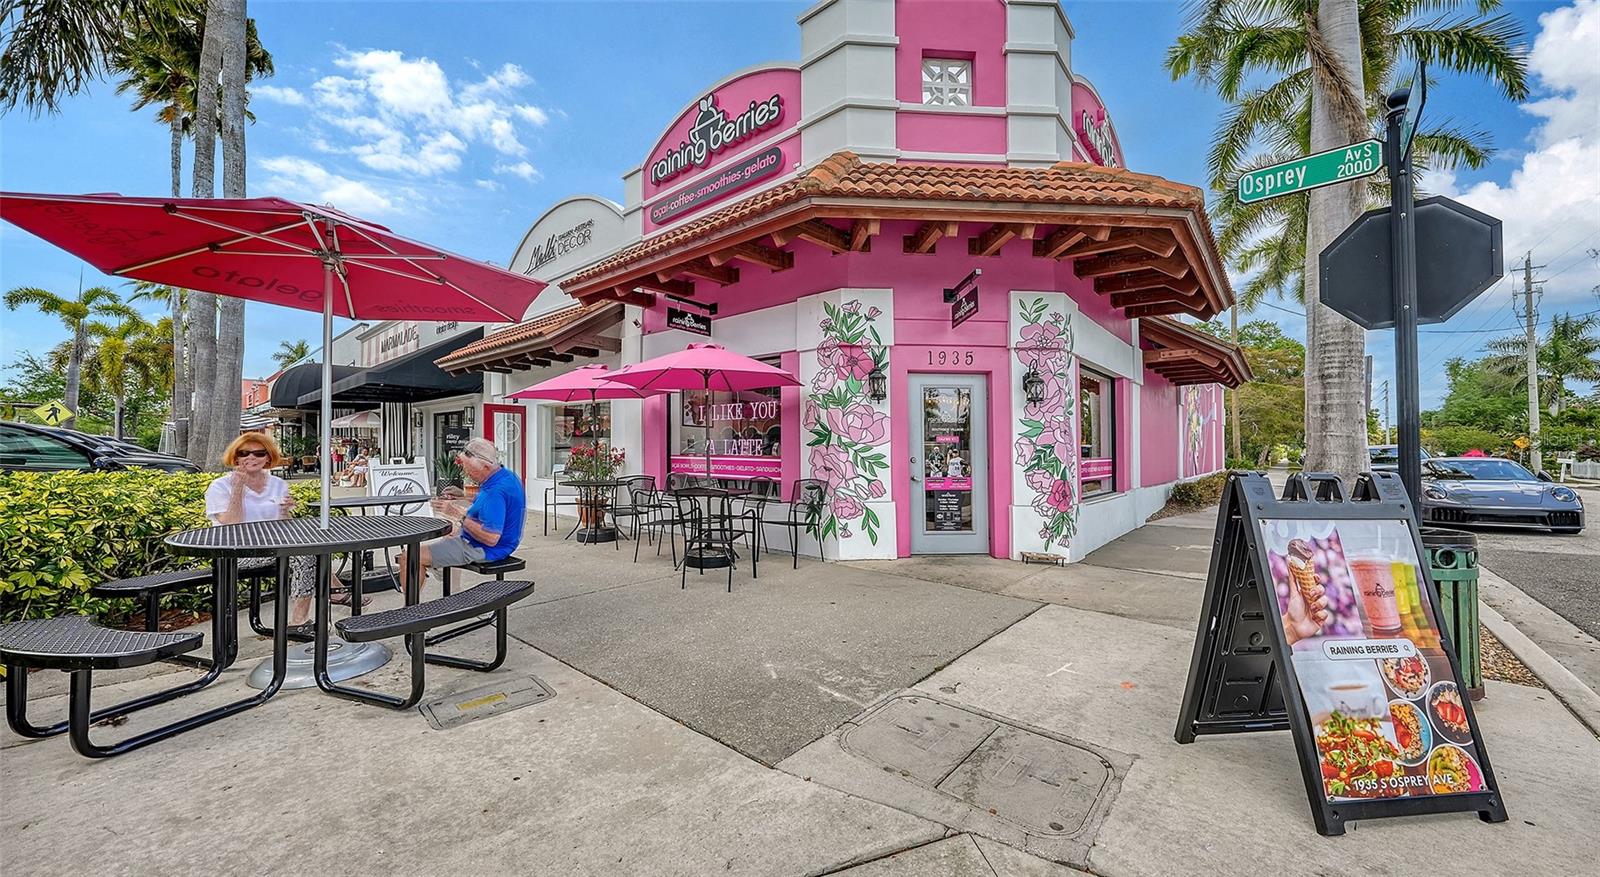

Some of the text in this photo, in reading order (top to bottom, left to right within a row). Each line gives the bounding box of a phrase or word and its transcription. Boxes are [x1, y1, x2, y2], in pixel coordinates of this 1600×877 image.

[652, 96, 779, 182] raining berries
[1345, 144, 1372, 162] Av S
[1337, 158, 1372, 178] 2000
[1243, 165, 1306, 195] Osprey
[558, 229, 592, 255] DECOR
[381, 325, 418, 353] MARMALADE
[928, 350, 974, 366] 1935
[699, 401, 777, 422] I LIKE YOU
[724, 438, 763, 456] LATTE
[1329, 645, 1399, 655] RAINING BERRIES
[1353, 773, 1454, 791] 1935 S OSPREY AVE
